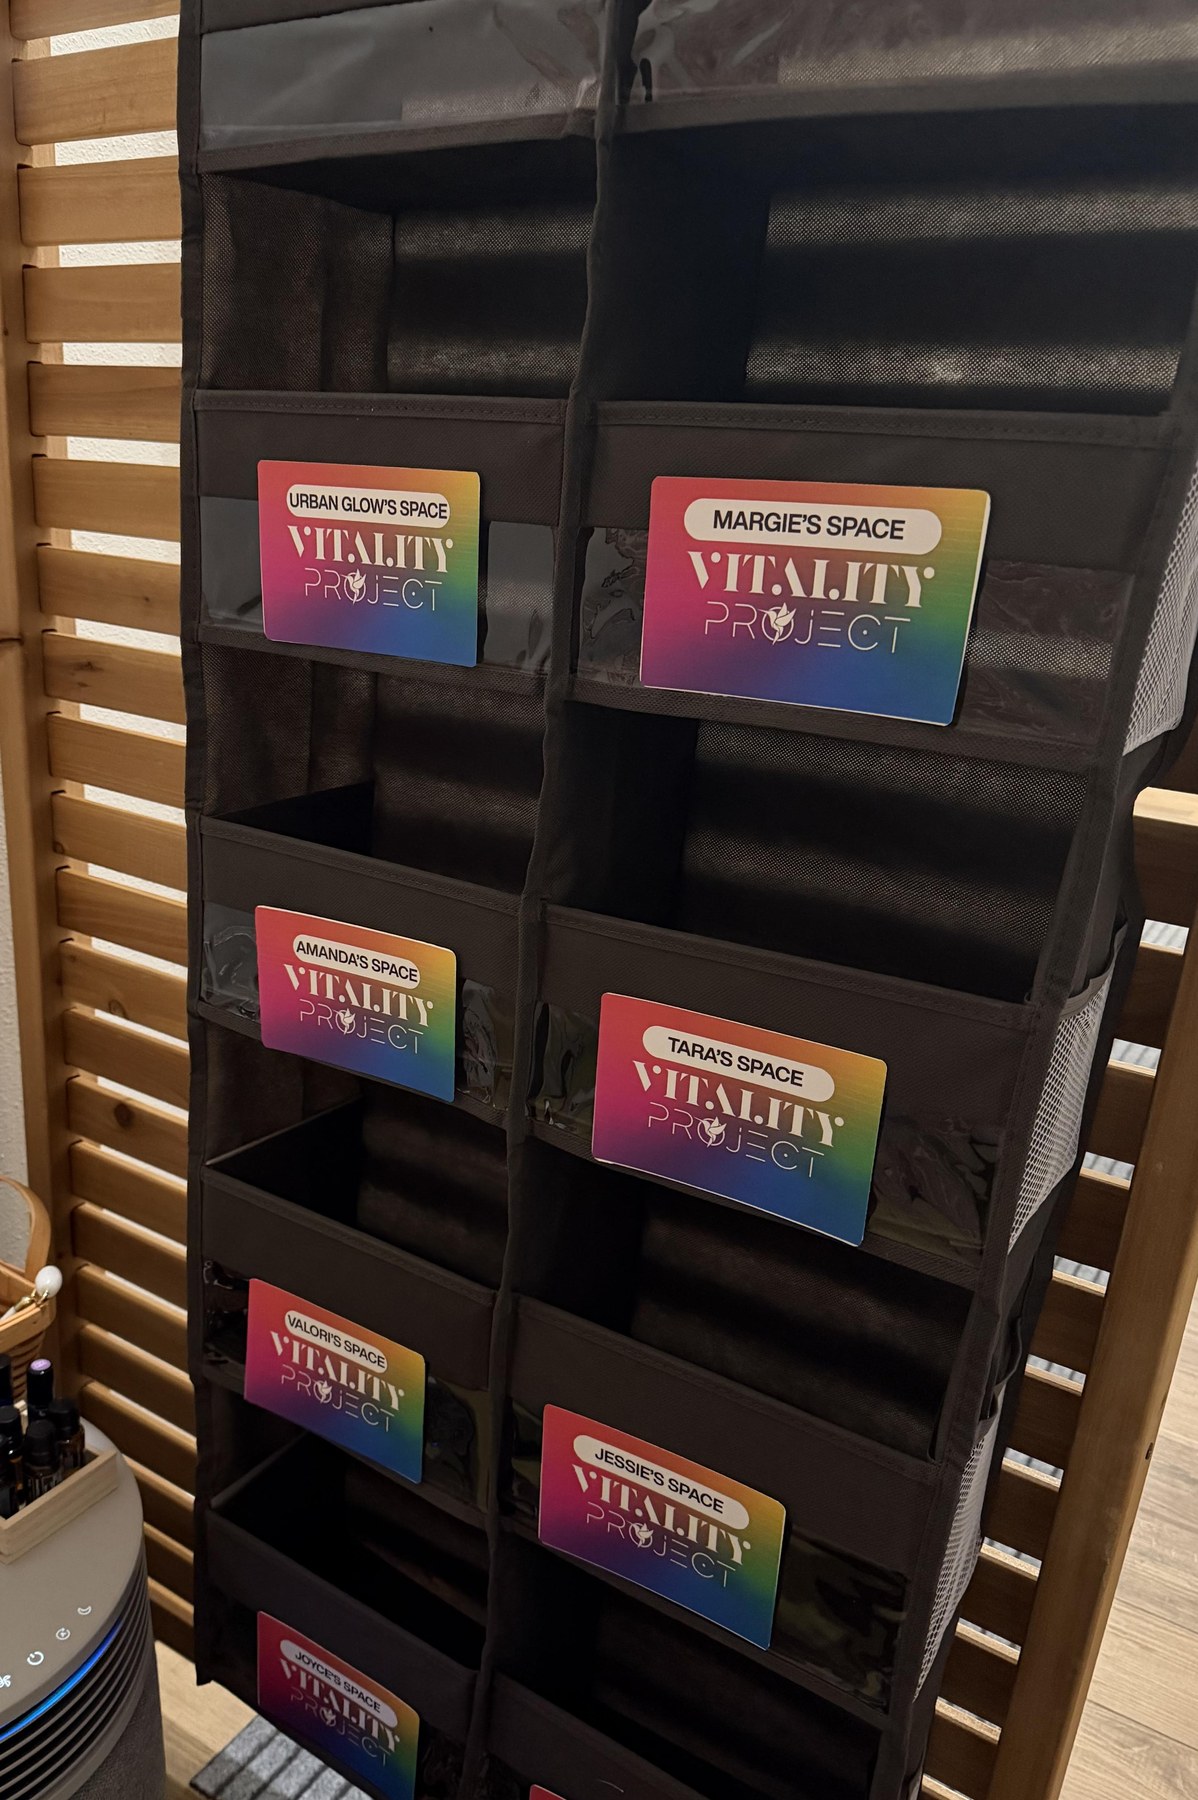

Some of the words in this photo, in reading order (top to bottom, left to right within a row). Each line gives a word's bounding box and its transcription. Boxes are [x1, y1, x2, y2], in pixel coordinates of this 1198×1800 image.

[289, 493, 338, 510] URBAN
[342, 496, 397, 515] GLOW'S
[400, 501, 447, 519] SPACE
[713, 510, 821, 535] MARGIE'S
[826, 516, 905, 540] SPACE
[287, 525, 453, 572] VITALITY
[304, 568, 442, 611] PROJECT
[687, 550, 935, 608] VITALITY
[704, 601, 911, 653] PROJECT
[296, 941, 368, 969] AMANDA'S
[371, 958, 418, 982] SPACE
[283, 964, 434, 1027] VITALITY
[300, 999, 423, 1054] PROJECT
[668, 1037, 733, 1067] TARA'S
[737, 1056, 804, 1087] SPACE
[632, 1060, 844, 1147] VITALITY
[648, 1101, 824, 1178] PROJECT
[270, 1331, 404, 1411] VITALITY
[287, 1314, 341, 1348] VALORI'S
[344, 1340, 385, 1369] SPACE
[281, 1364, 394, 1432] PROJECT
[595, 1448, 664, 1486] JESSIE'S
[668, 1478, 724, 1514] SPACE
[572, 1464, 751, 1565] VITALITY
[586, 1501, 736, 1588] PROJECT
[280, 1658, 400, 1752] VITALITY
[295, 1652, 341, 1686] JOYCE'S
[343, 1681, 381, 1713] SPACE
